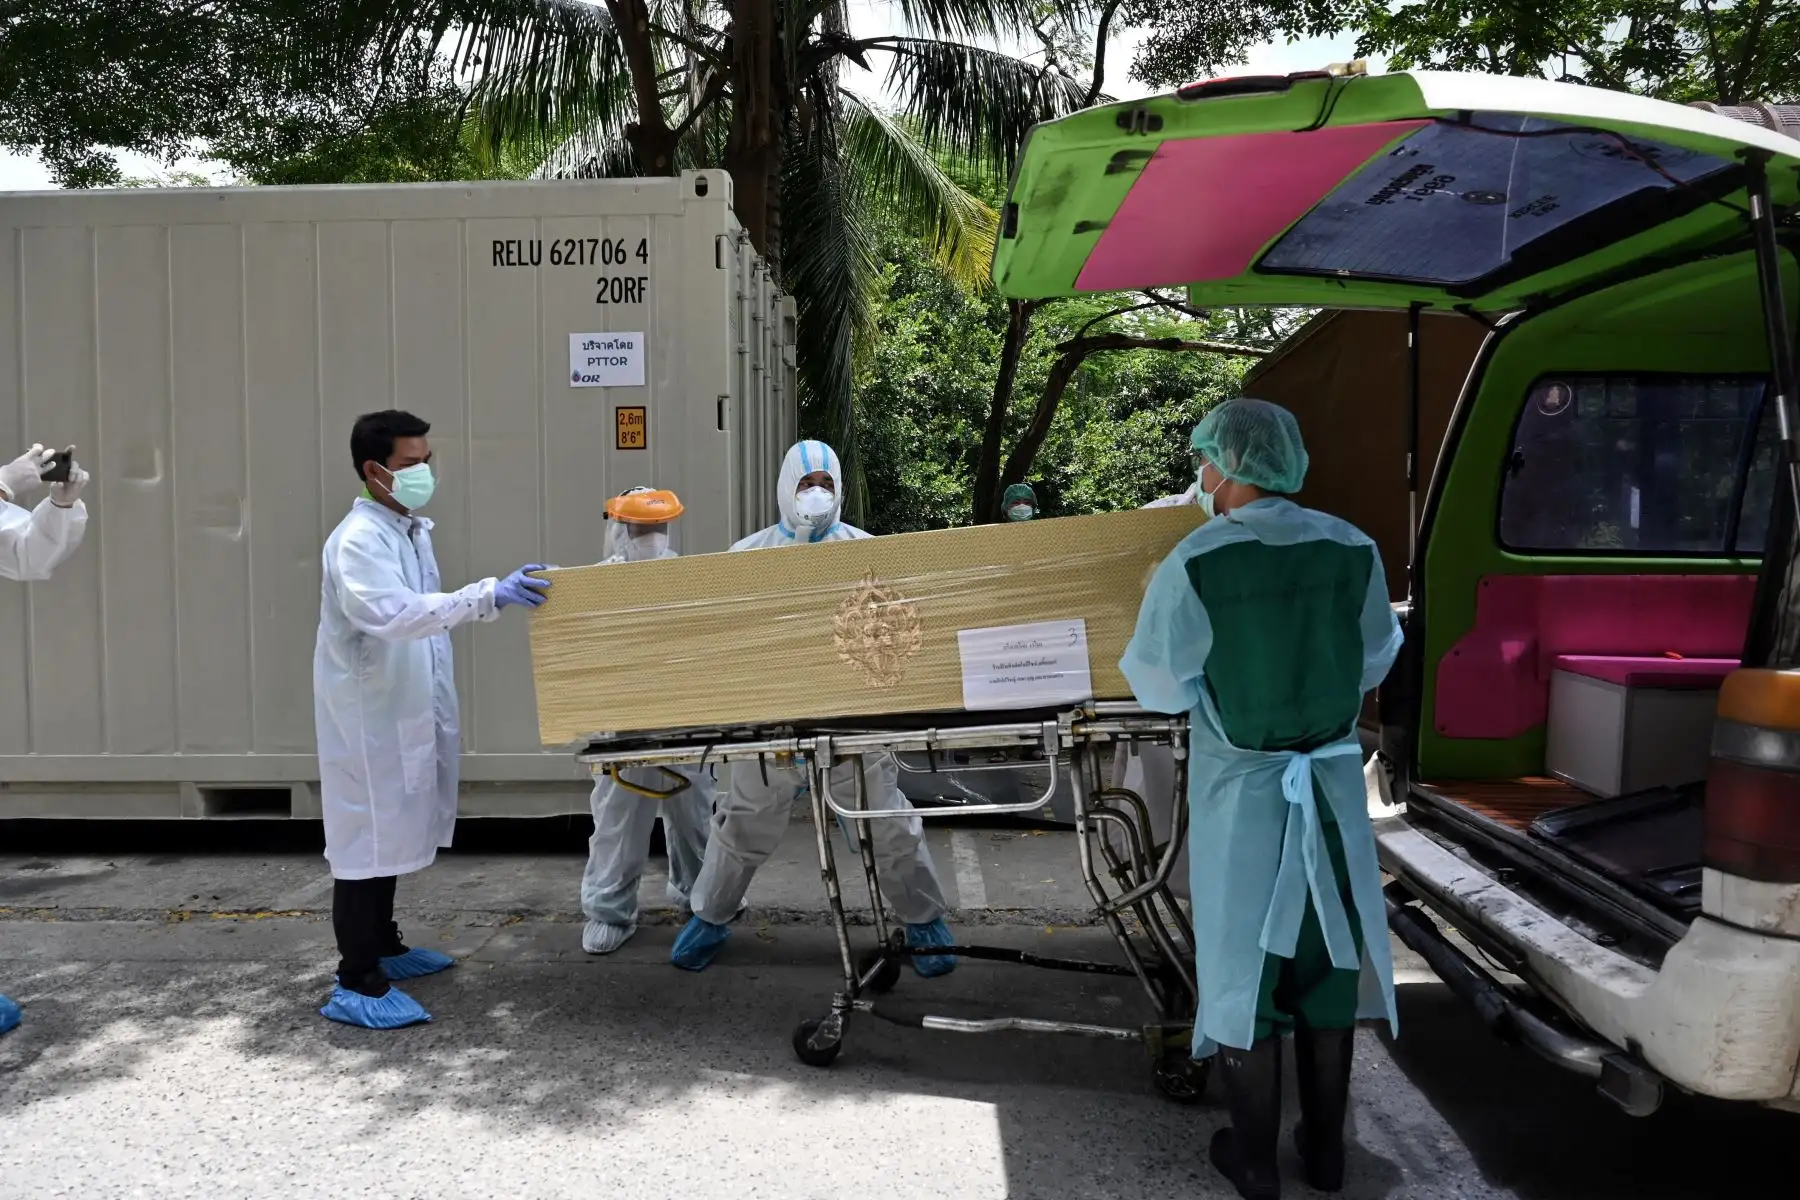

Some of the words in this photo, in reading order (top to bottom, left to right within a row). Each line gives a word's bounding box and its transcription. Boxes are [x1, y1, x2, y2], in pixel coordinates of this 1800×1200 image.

[492, 240, 542, 266] RELU
[550, 238, 627, 265] 621706
[635, 238, 649, 265] 4
[596, 276, 649, 304] 20RF
[582, 338, 633, 351] บริจาคโดย
[587, 356, 628, 367] PTTOR
[581, 374, 600, 383] OR
[619, 412, 643, 428] 2,6m
